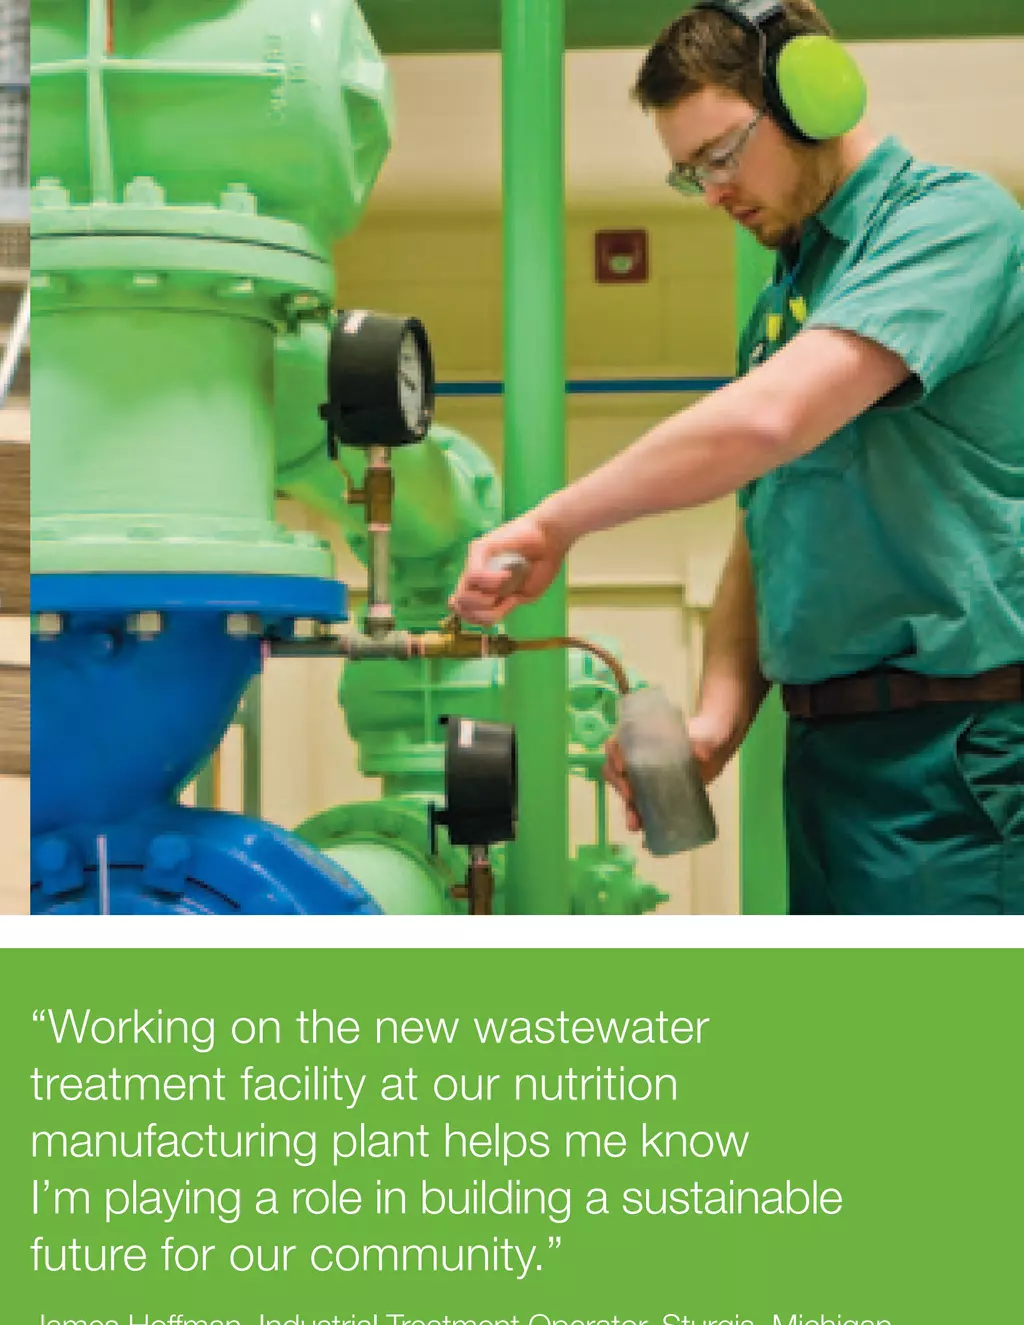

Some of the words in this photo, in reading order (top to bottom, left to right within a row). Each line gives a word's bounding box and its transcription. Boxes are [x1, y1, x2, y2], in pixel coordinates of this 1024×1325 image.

[231, 1017, 281, 1045] on
[295, 1008, 361, 1045] the
[376, 1017, 460, 1045] new
[473, 1010, 711, 1045] wastewater
[29, 1067, 226, 1102] treatment
[239, 1065, 367, 1110] facility
[380, 1067, 419, 1102] at
[433, 1073, 501, 1102] our
[515, 1065, 677, 1102] nutrition
[31, 1122, 317, 1167] manufacturing
[333, 1122, 430, 1167] plant
[445, 1122, 551, 1167] helps
[565, 1130, 627, 1158] me
[641, 1122, 750, 1158] know
[105, 1179, 241, 1224] playing
[255, 1187, 280, 1215] a
[292, 1179, 363, 1215] role
[376, 1179, 406, 1215] in
[421, 1179, 571, 1224] building
[585, 1187, 610, 1215] a
[622, 1179, 843, 1215] sustainable
[29, 1235, 147, 1272] future
[160, 1235, 216, 1272] for
[229, 1244, 297, 1272] our
